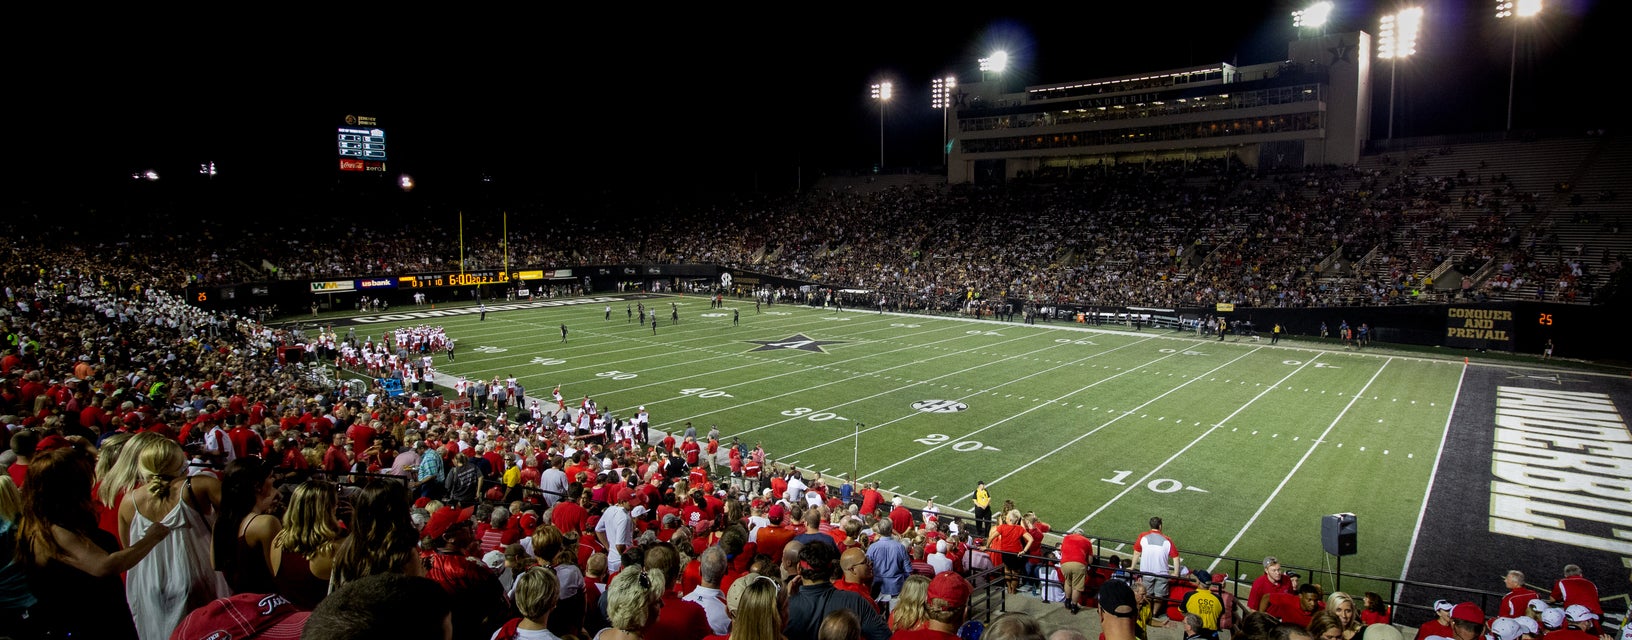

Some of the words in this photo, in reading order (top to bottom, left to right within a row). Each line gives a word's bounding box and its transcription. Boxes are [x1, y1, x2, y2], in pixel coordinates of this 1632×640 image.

[1078, 93, 1160, 107] VANDERBILT
[449, 274, 472, 285] 6:00
[1448, 307, 1512, 321] CONQUER
[1539, 313, 1553, 325] 25
[1464, 318, 1494, 329] AND
[1447, 327, 1509, 341] PREVAIL
[595, 370, 638, 380] 50
[679, 387, 726, 398] 40
[781, 407, 837, 421] 30
[913, 433, 983, 452] 20
[1101, 470, 1184, 493] 10
[1489, 385, 1632, 568] VANDERBILT
[1198, 598, 1214, 607] CSC
